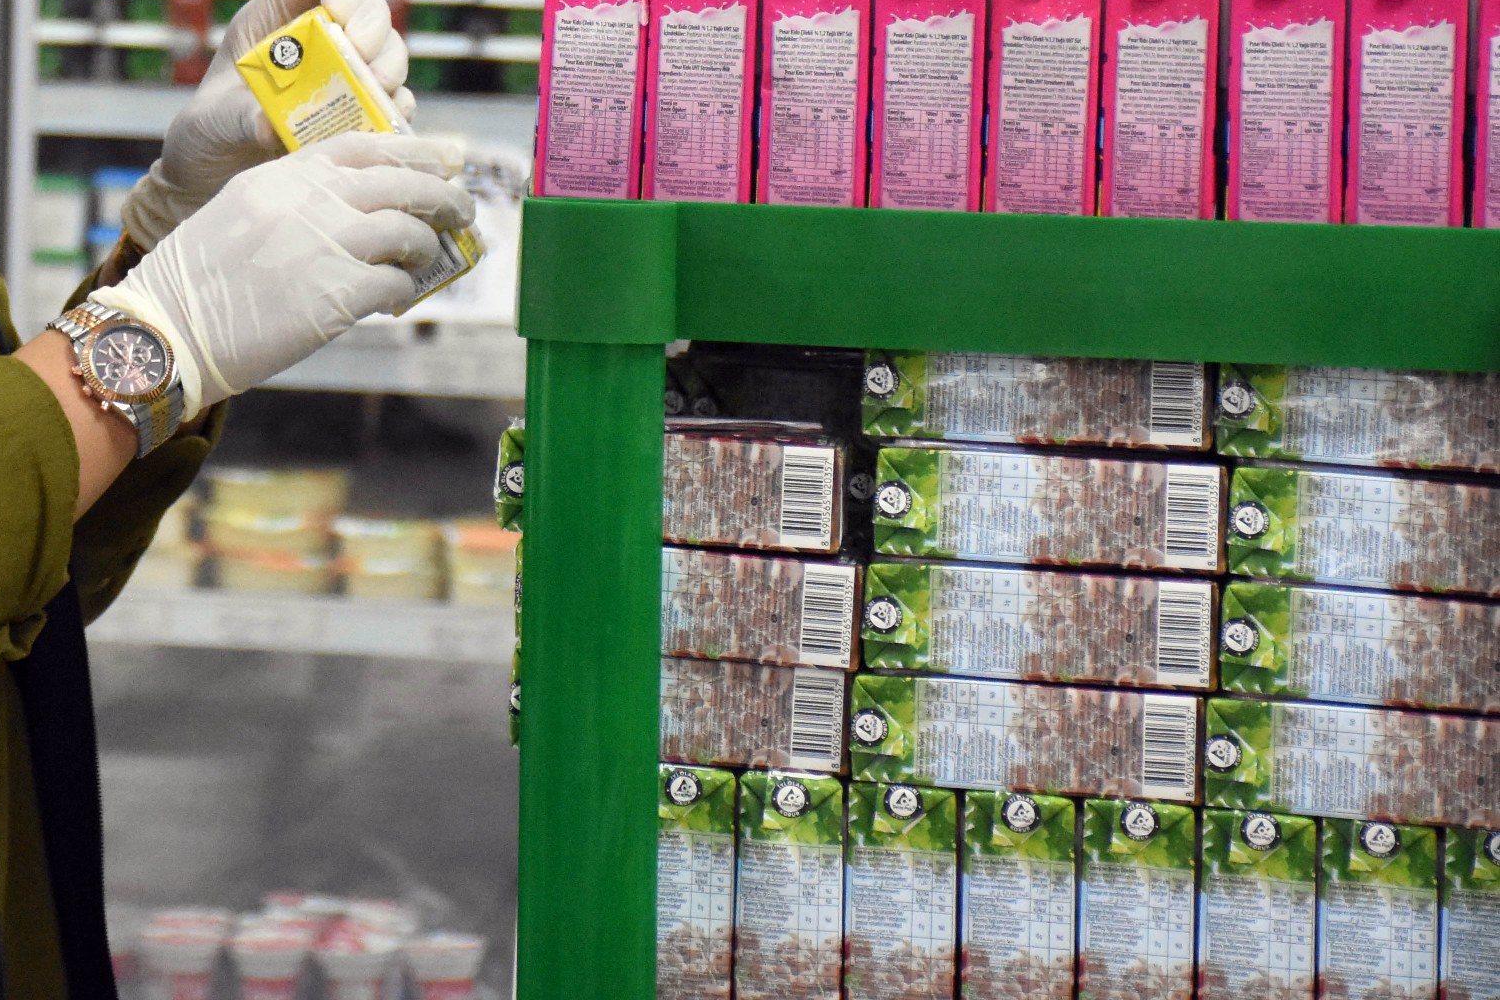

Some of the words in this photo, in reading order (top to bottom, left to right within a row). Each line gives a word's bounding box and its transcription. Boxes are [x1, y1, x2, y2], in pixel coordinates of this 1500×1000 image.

[1193, 396, 1202, 430] 690565
[823, 460, 833, 496] 020357
[1208, 479, 1218, 515] 020357
[822, 500, 831, 534] 690565
[1208, 519, 1217, 554] 690565
[844, 578, 853, 613] 020357
[866, 600, 875, 619] OLANI
[1201, 596, 1210, 632] 020357
[842, 618, 851, 653] 690565
[1200, 636, 1209, 672] 690565
[834, 682, 843, 717] 020357
[832, 722, 841, 757] 690565
[1187, 709, 1196, 745] 020357
[1186, 750, 1195, 786] 690565
[787, 781, 806, 791] OLANI
[1017, 795, 1036, 806] OLANI
